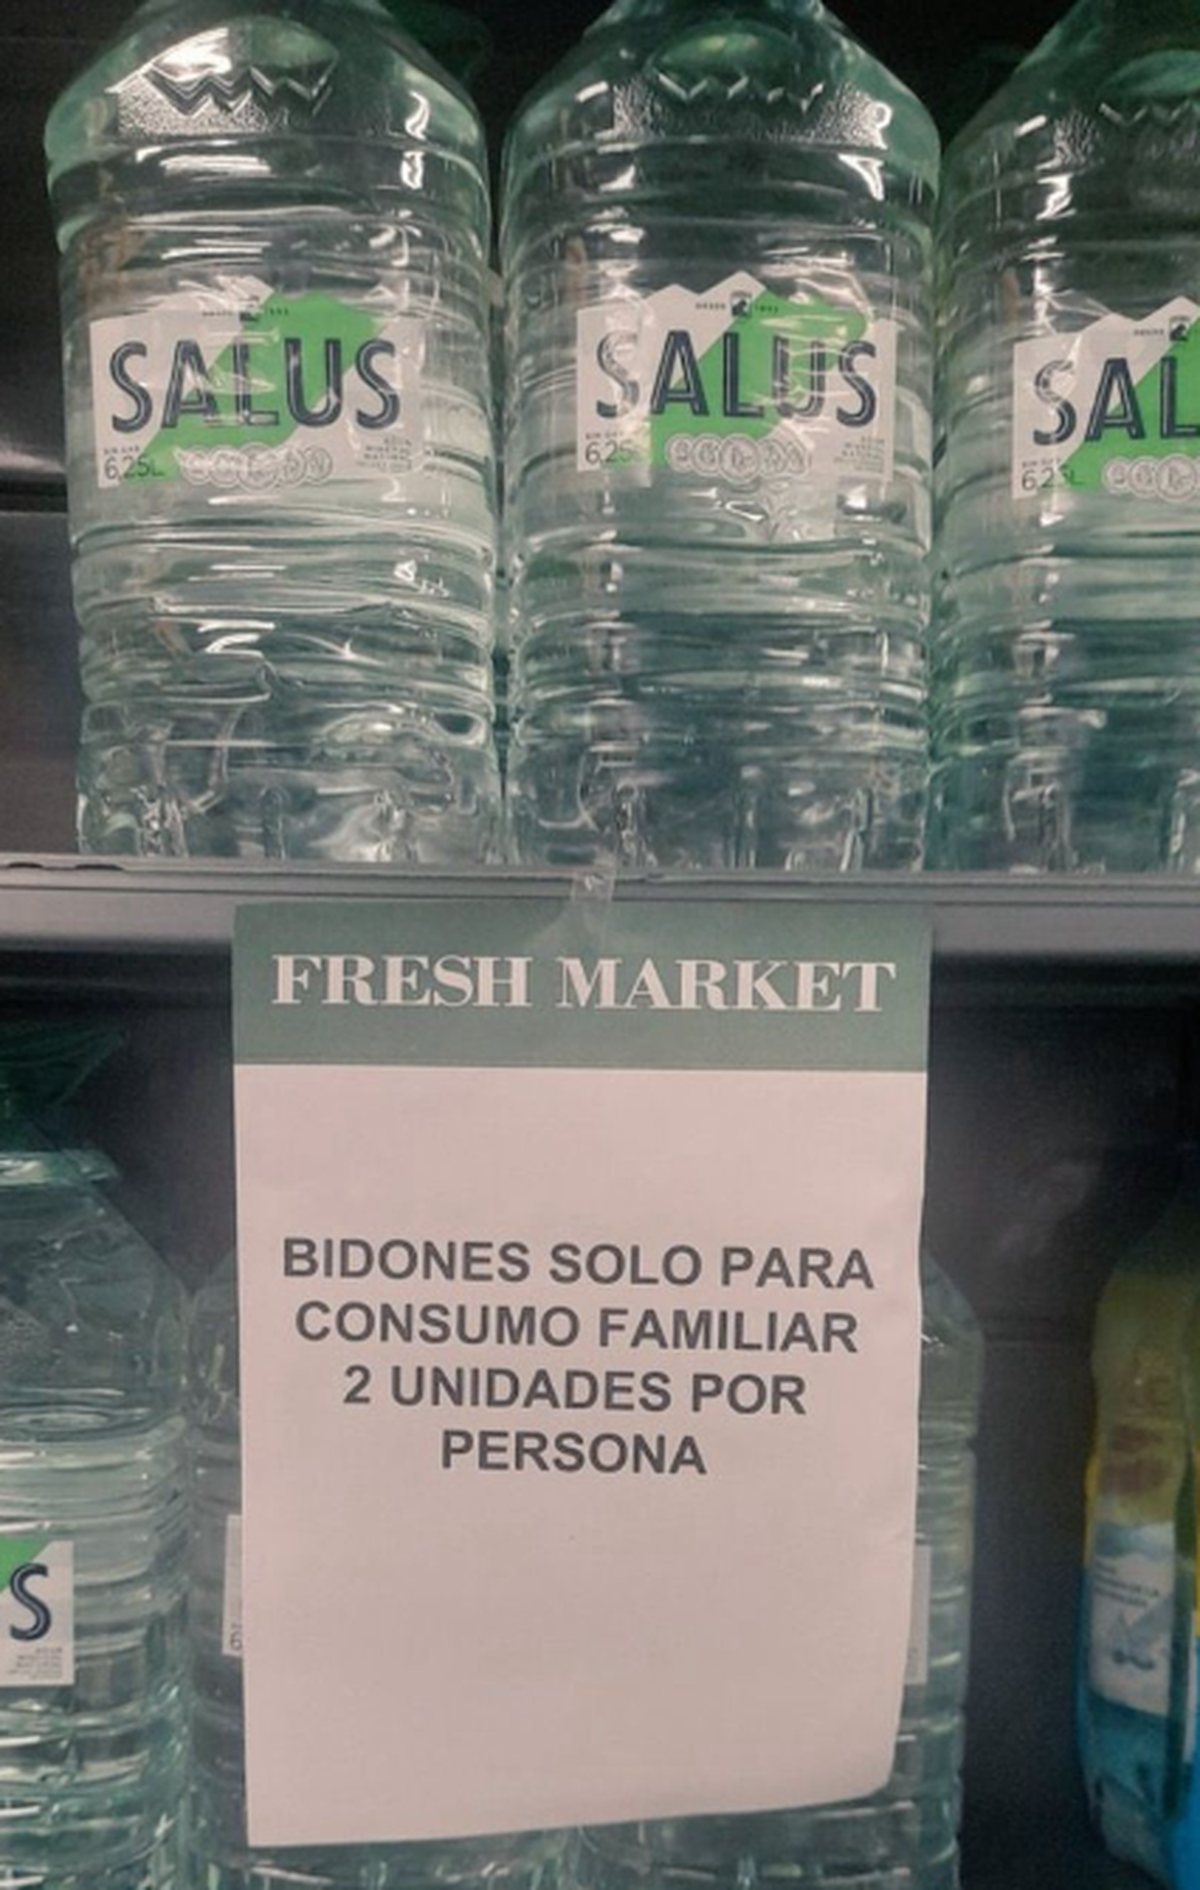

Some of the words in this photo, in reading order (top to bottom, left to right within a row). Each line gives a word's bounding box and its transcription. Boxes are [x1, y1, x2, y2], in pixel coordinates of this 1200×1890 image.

[109, 337, 401, 434] SALUS
[596, 329, 877, 428] SALUS
[271, 954, 531, 1008] FRESH
[556, 957, 896, 1013] MARKET
[282, 1238, 531, 1283] BIDONES
[548, 1244, 702, 1287] SOLO
[720, 1247, 874, 1290] PARA
[295, 1301, 580, 1347] CONSUMO
[599, 1309, 858, 1354] FAMILIAR
[343, 1366, 371, 1405] 2
[391, 1367, 671, 1413] UNIDADES
[691, 1374, 806, 1415] POR
[441, 1430, 707, 1475] PERSONA
